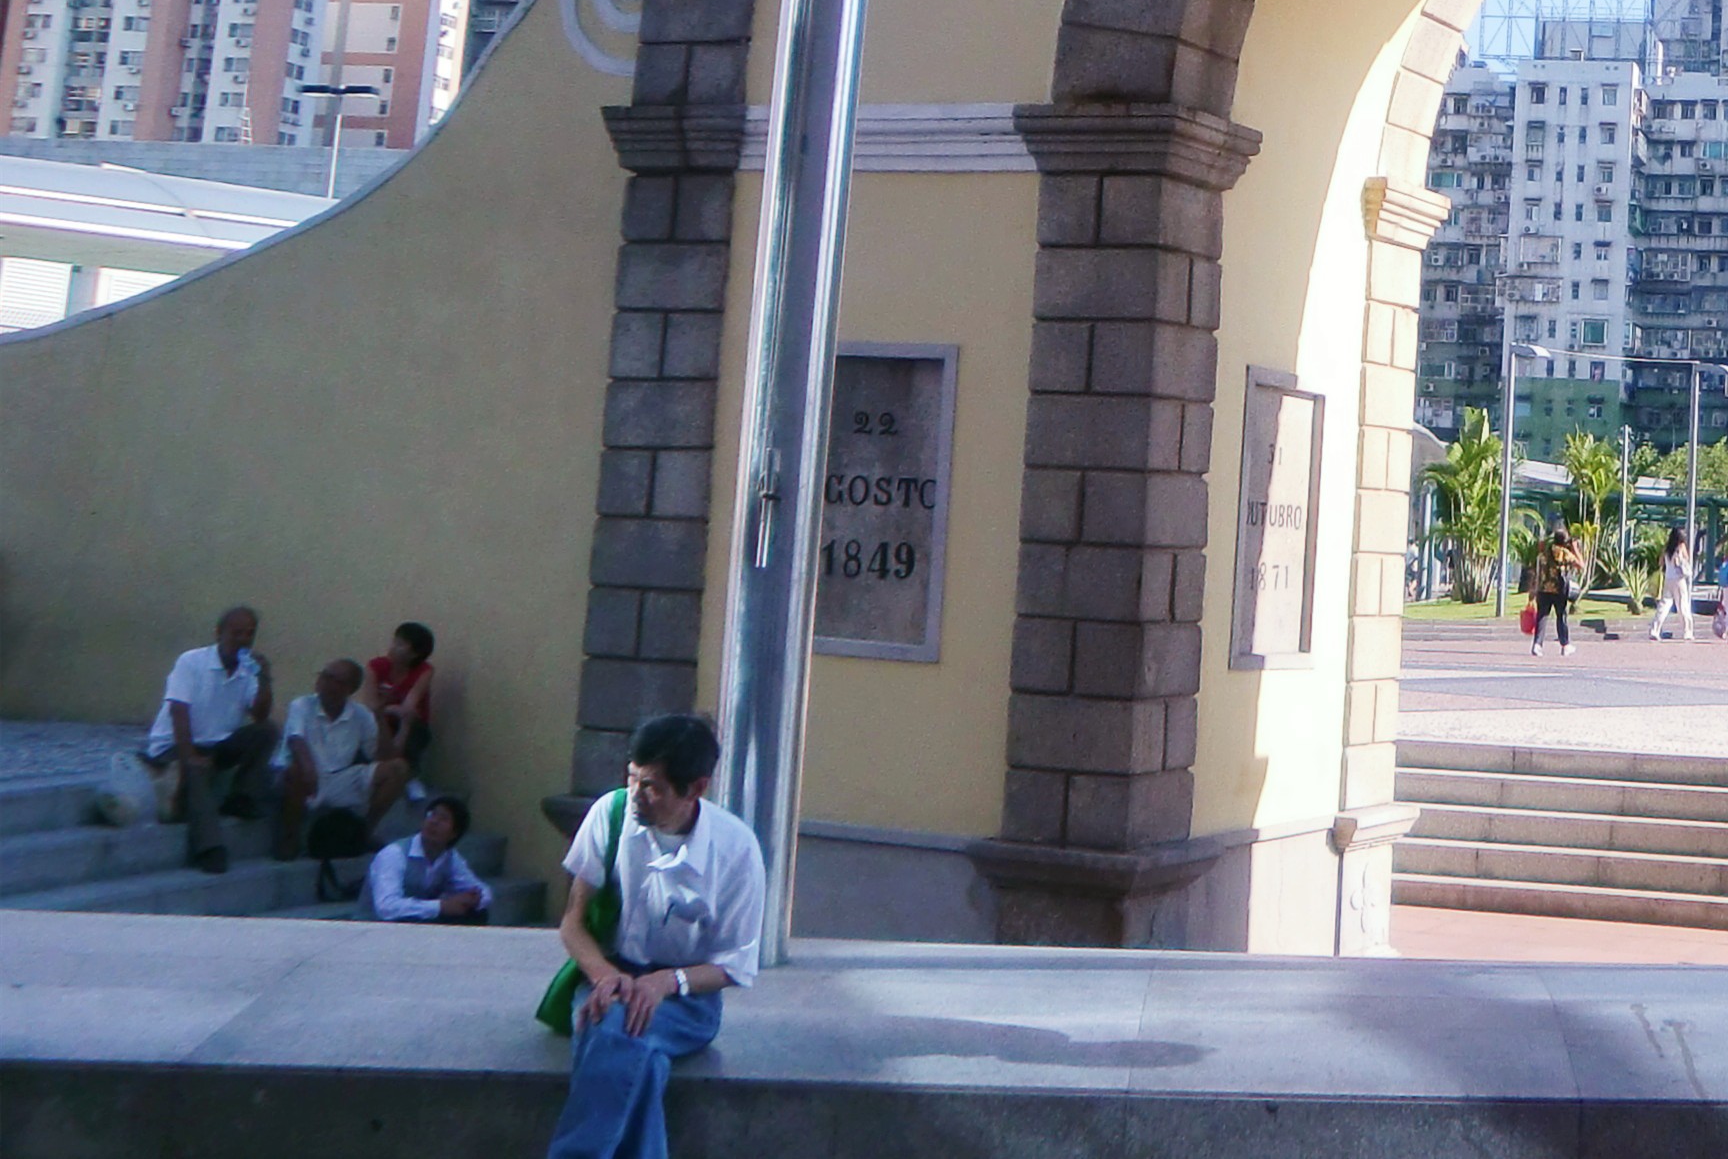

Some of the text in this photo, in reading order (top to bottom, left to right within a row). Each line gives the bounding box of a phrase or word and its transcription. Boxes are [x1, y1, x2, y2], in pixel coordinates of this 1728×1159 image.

[853, 410, 898, 436] 22
[1268, 443, 1283, 466] 31
[824, 474, 936, 510] GOSTO
[821, 538, 916, 580] 1849
[1250, 561, 1289, 591] 1871
